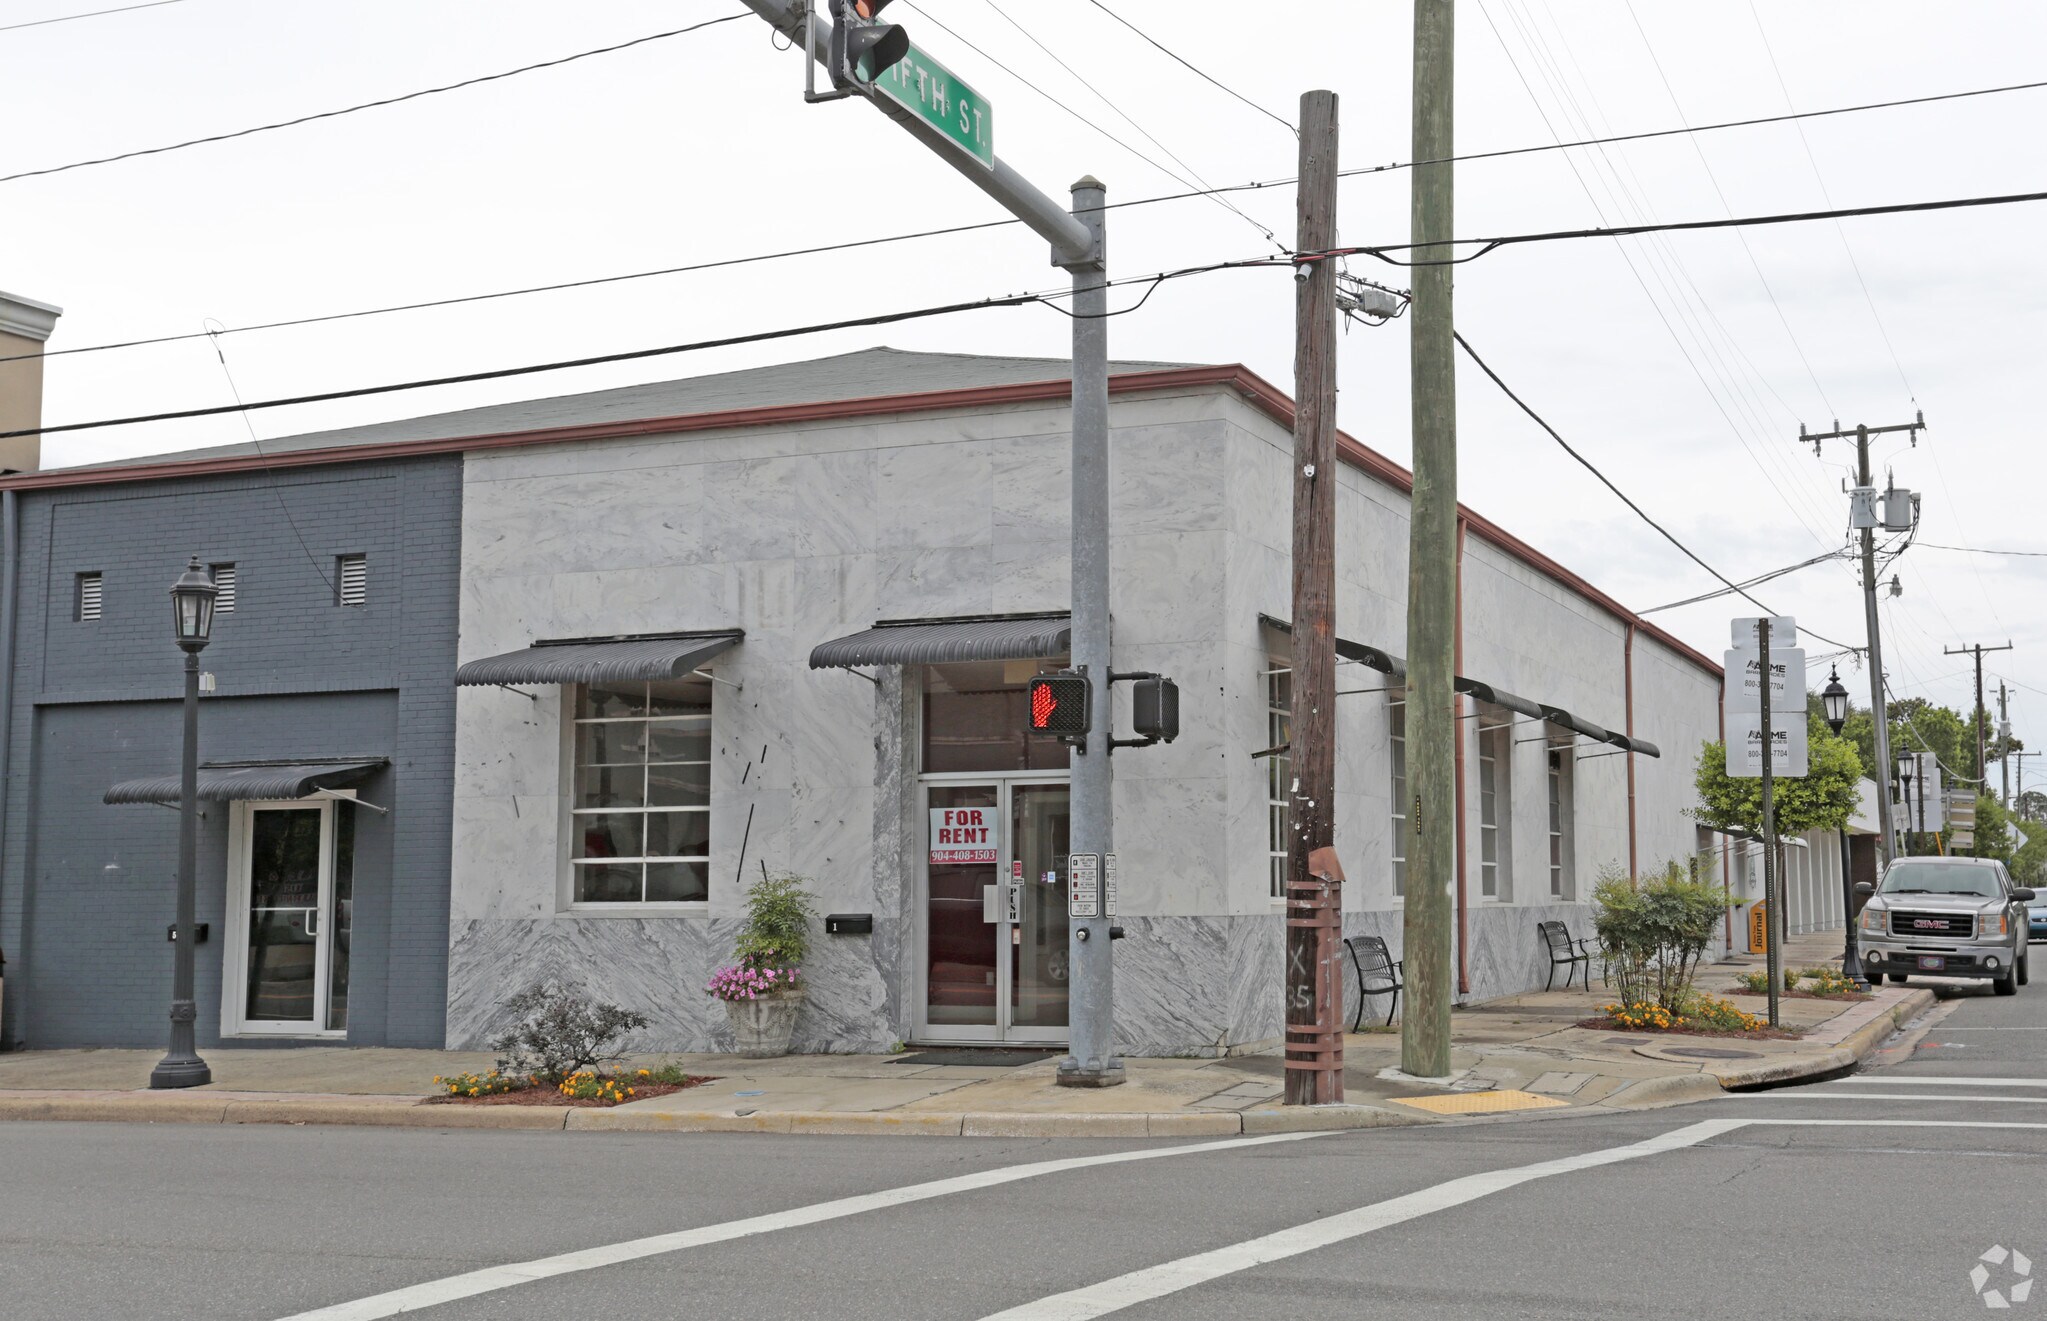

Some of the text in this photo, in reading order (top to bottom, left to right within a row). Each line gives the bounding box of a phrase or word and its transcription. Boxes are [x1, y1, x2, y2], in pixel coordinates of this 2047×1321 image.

[892, 56, 986, 148] IFTH ST.
[1747, 660, 1786, 673] AME
[1748, 730, 1787, 739] AME
[944, 809, 983, 826] FOR
[938, 827, 989, 844] RENT
[931, 850, 996, 862] 904-408-1503
[1754, 912, 1763, 950] Journal
[1913, 919, 1950, 930] GMC
